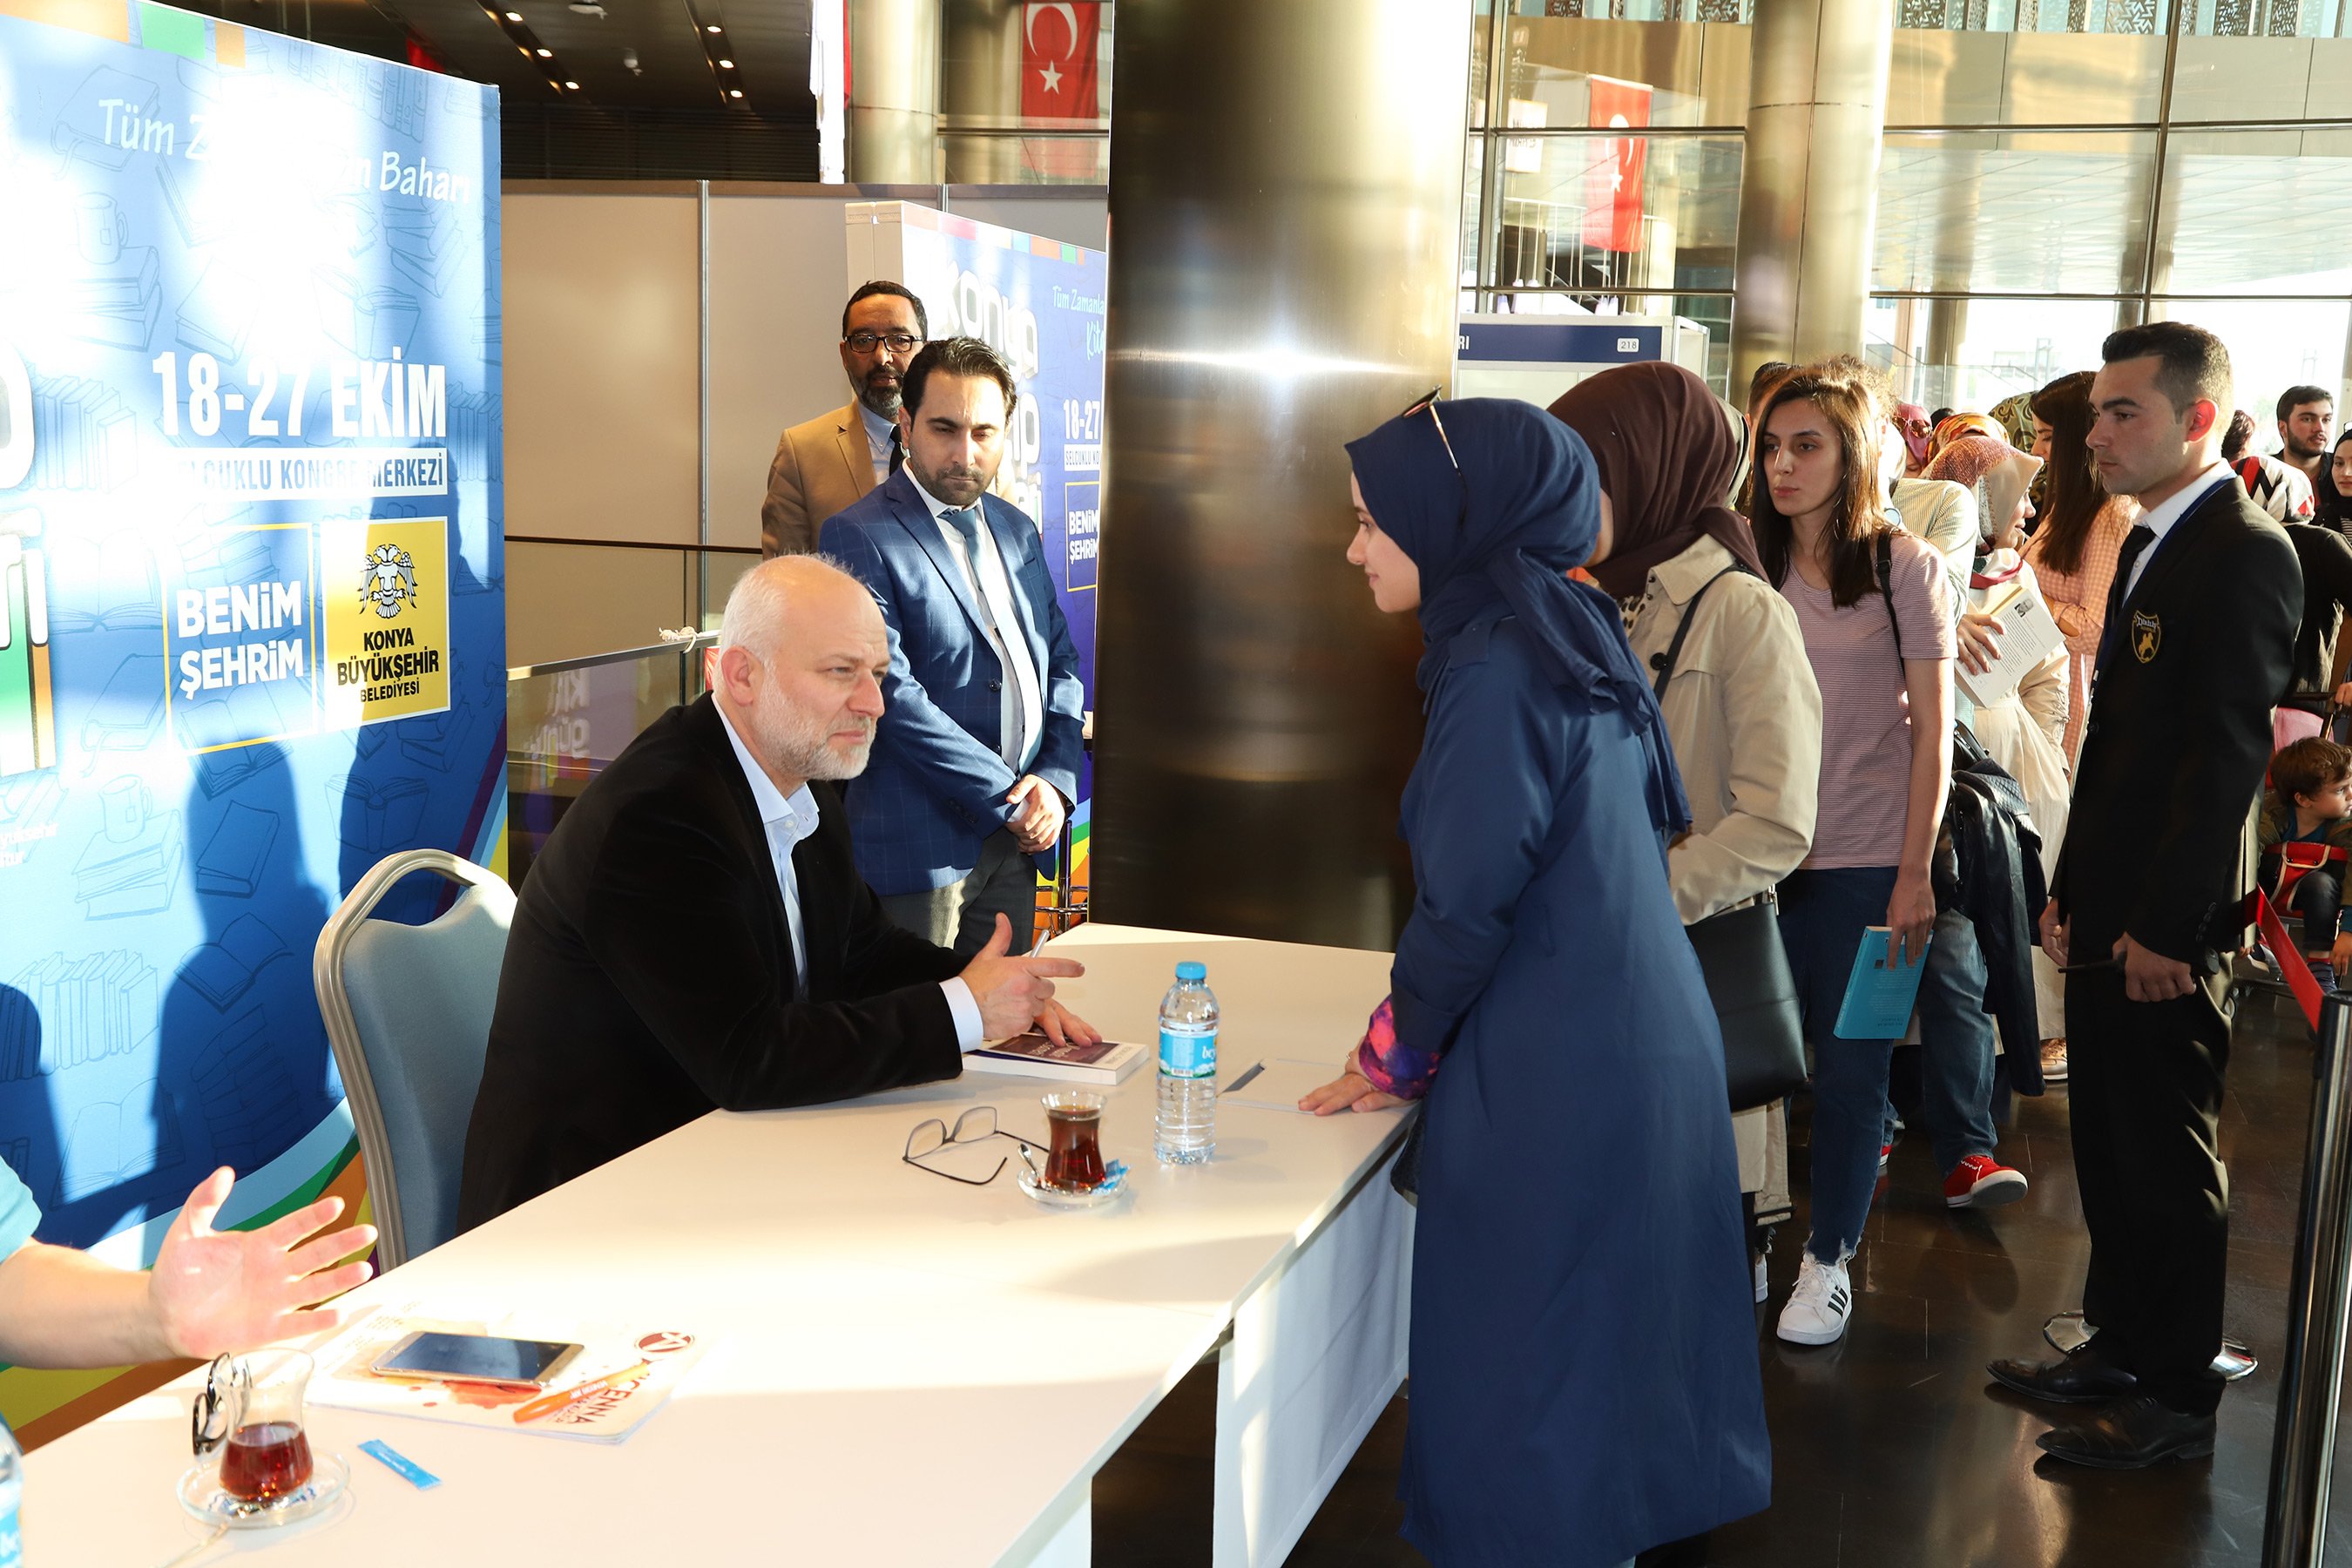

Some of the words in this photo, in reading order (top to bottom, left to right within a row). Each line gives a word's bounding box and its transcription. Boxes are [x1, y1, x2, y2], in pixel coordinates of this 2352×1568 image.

[98, 98, 174, 157] Tüm
[380, 150, 471, 205] Baharı
[1052, 285, 1070, 309] Tüm
[1621, 341, 1637, 350] 218
[152, 350, 312, 437] 18-27
[330, 346, 447, 437] EKİM
[1064, 399, 1100, 440] 18-27
[368, 452, 443, 488] MERKEZİ
[176, 580, 303, 639] BENİM
[363, 627, 416, 652] KONYA
[179, 639, 305, 700] ŞEHRİM
[337, 645, 440, 687] BÜYÜKŞEHİR
[360, 677, 421, 703] BELEDİYESİ
